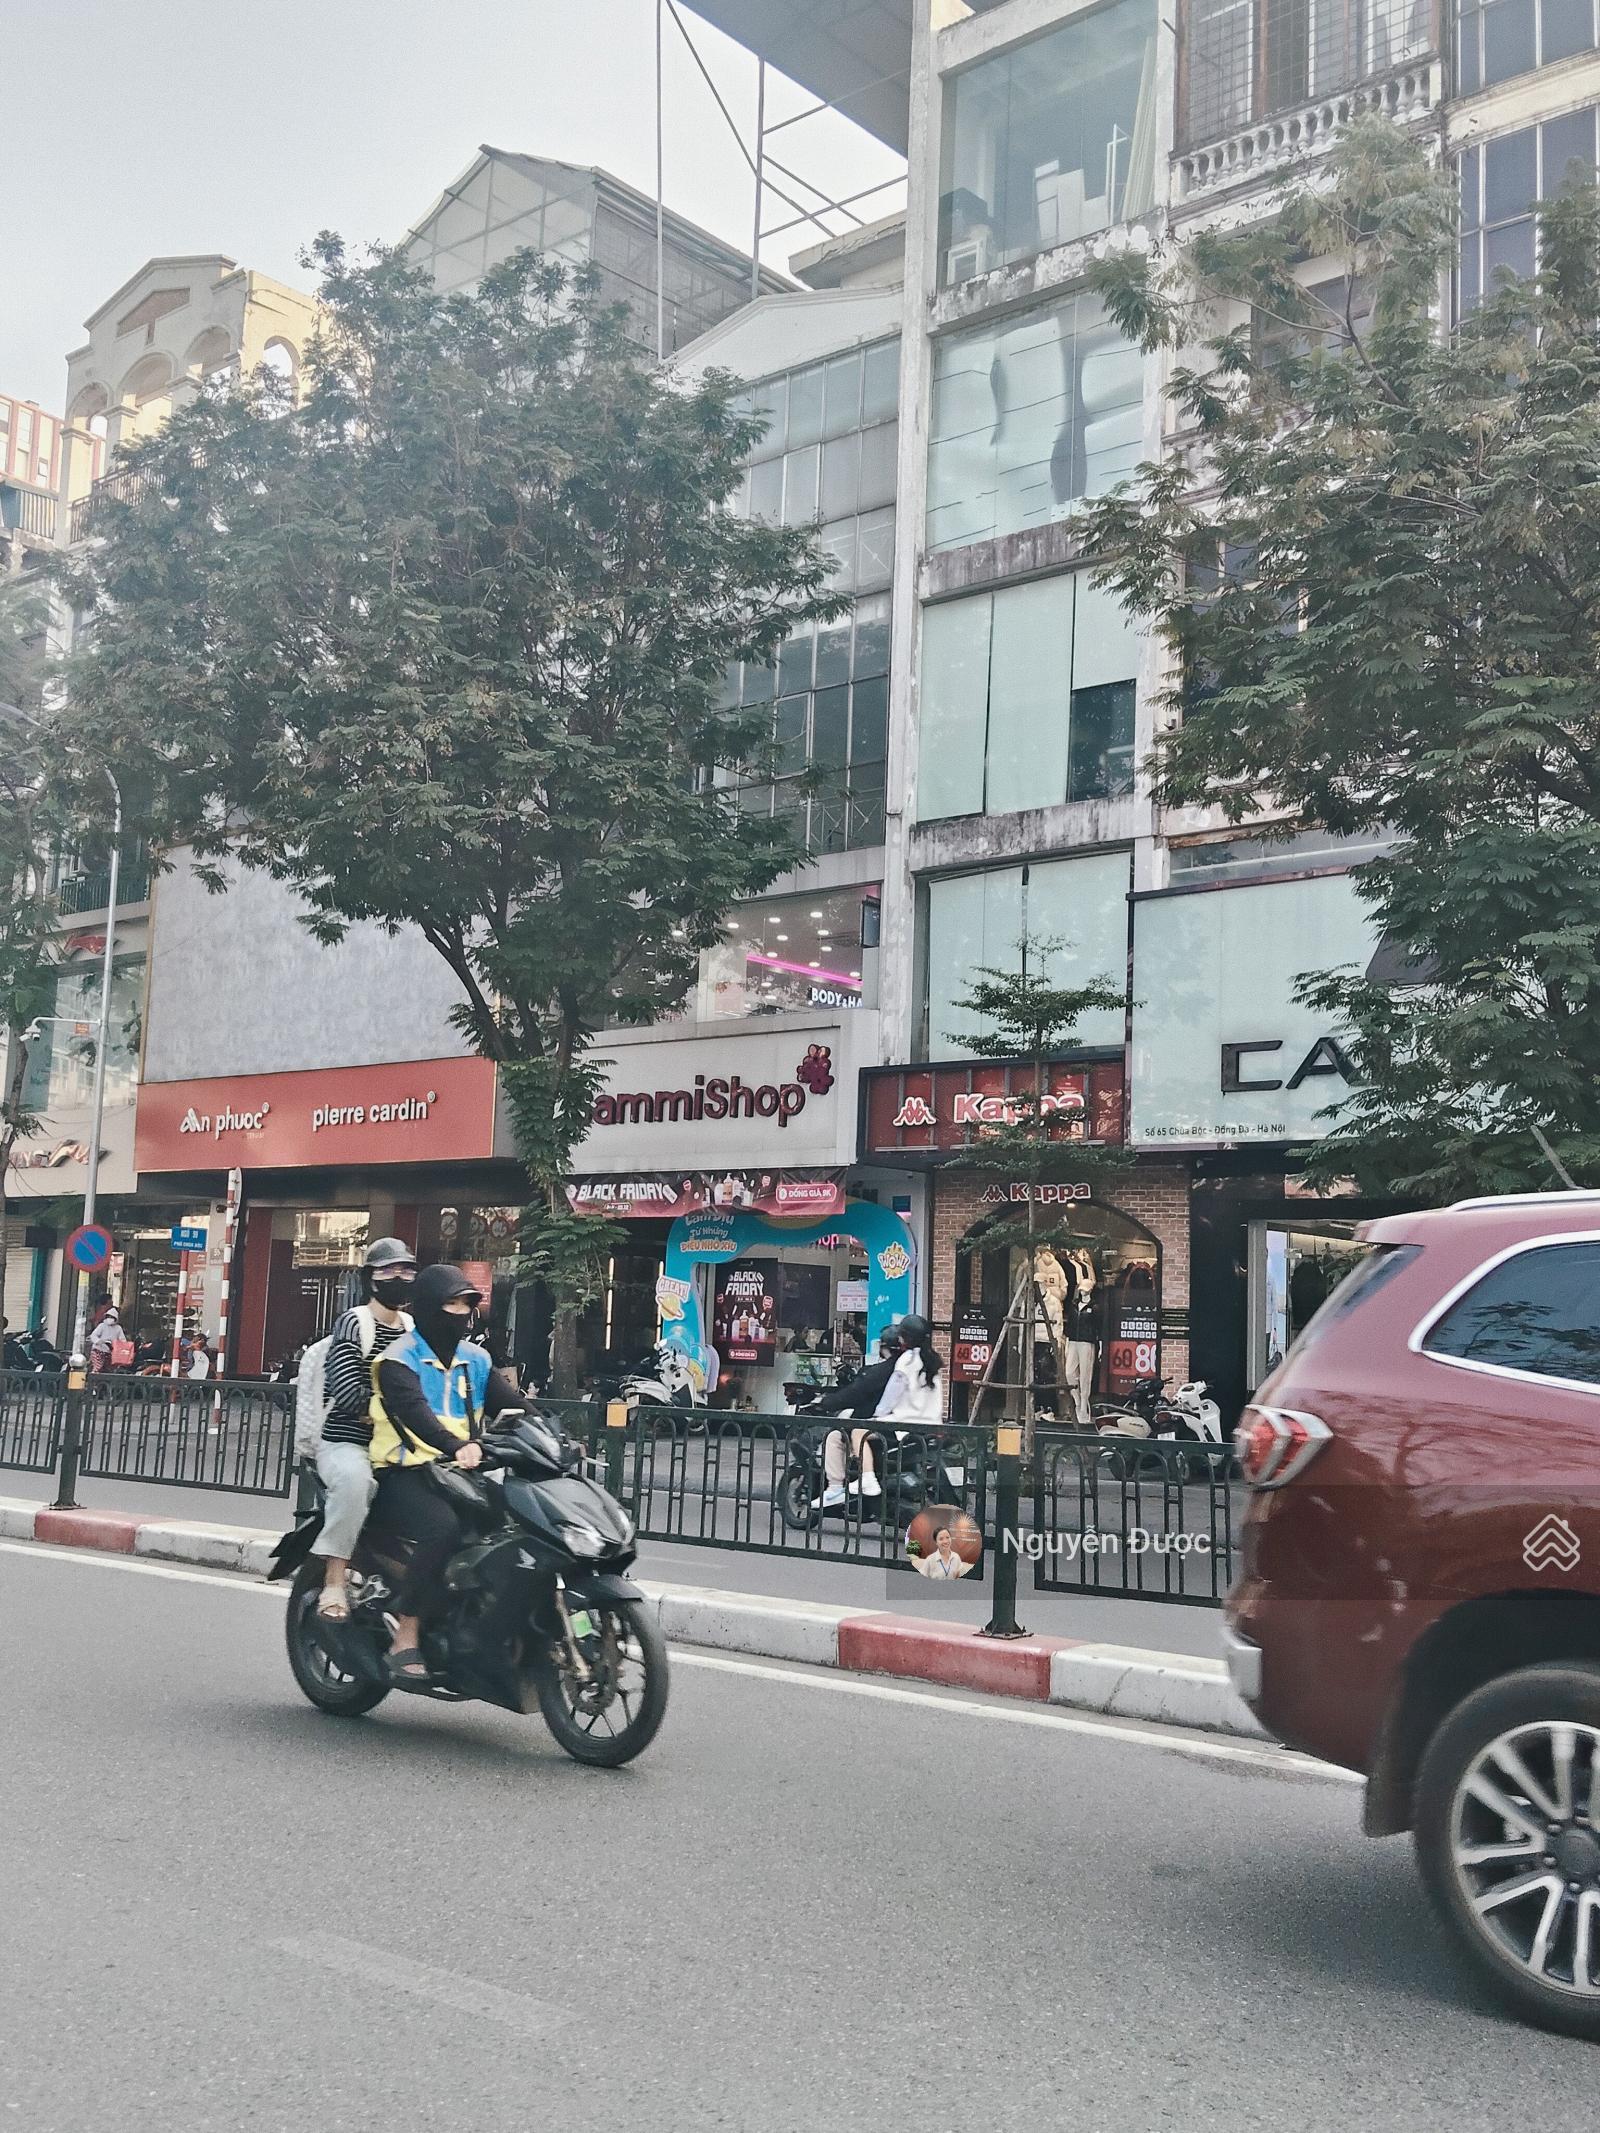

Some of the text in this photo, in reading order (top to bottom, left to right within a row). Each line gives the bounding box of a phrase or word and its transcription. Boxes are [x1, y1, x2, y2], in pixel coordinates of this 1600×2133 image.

[811, 987, 842, 1006] BODY
[592, 1075, 806, 1127] ammiShop
[215, 1105, 263, 1140] phuoc
[313, 1104, 364, 1131] pierre
[369, 1098, 427, 1123] cardin
[1145, 1126, 1156, 1136] Số
[1157, 1127, 1167, 1136] 65
[1257, 1124, 1269, 1133] Hà
[1271, 1124, 1286, 1133] Nội
[576, 1183, 664, 1201] BLACK FRIDAY
[1010, 1182, 1091, 1204] Kappa
[879, 1253, 910, 1270] WOW!
[733, 1271, 758, 1282] BLACK
[725, 1283, 764, 1296] FRIDAY
[971, 1345, 990, 1362] 80
[1113, 1349, 1133, 1368] 60
